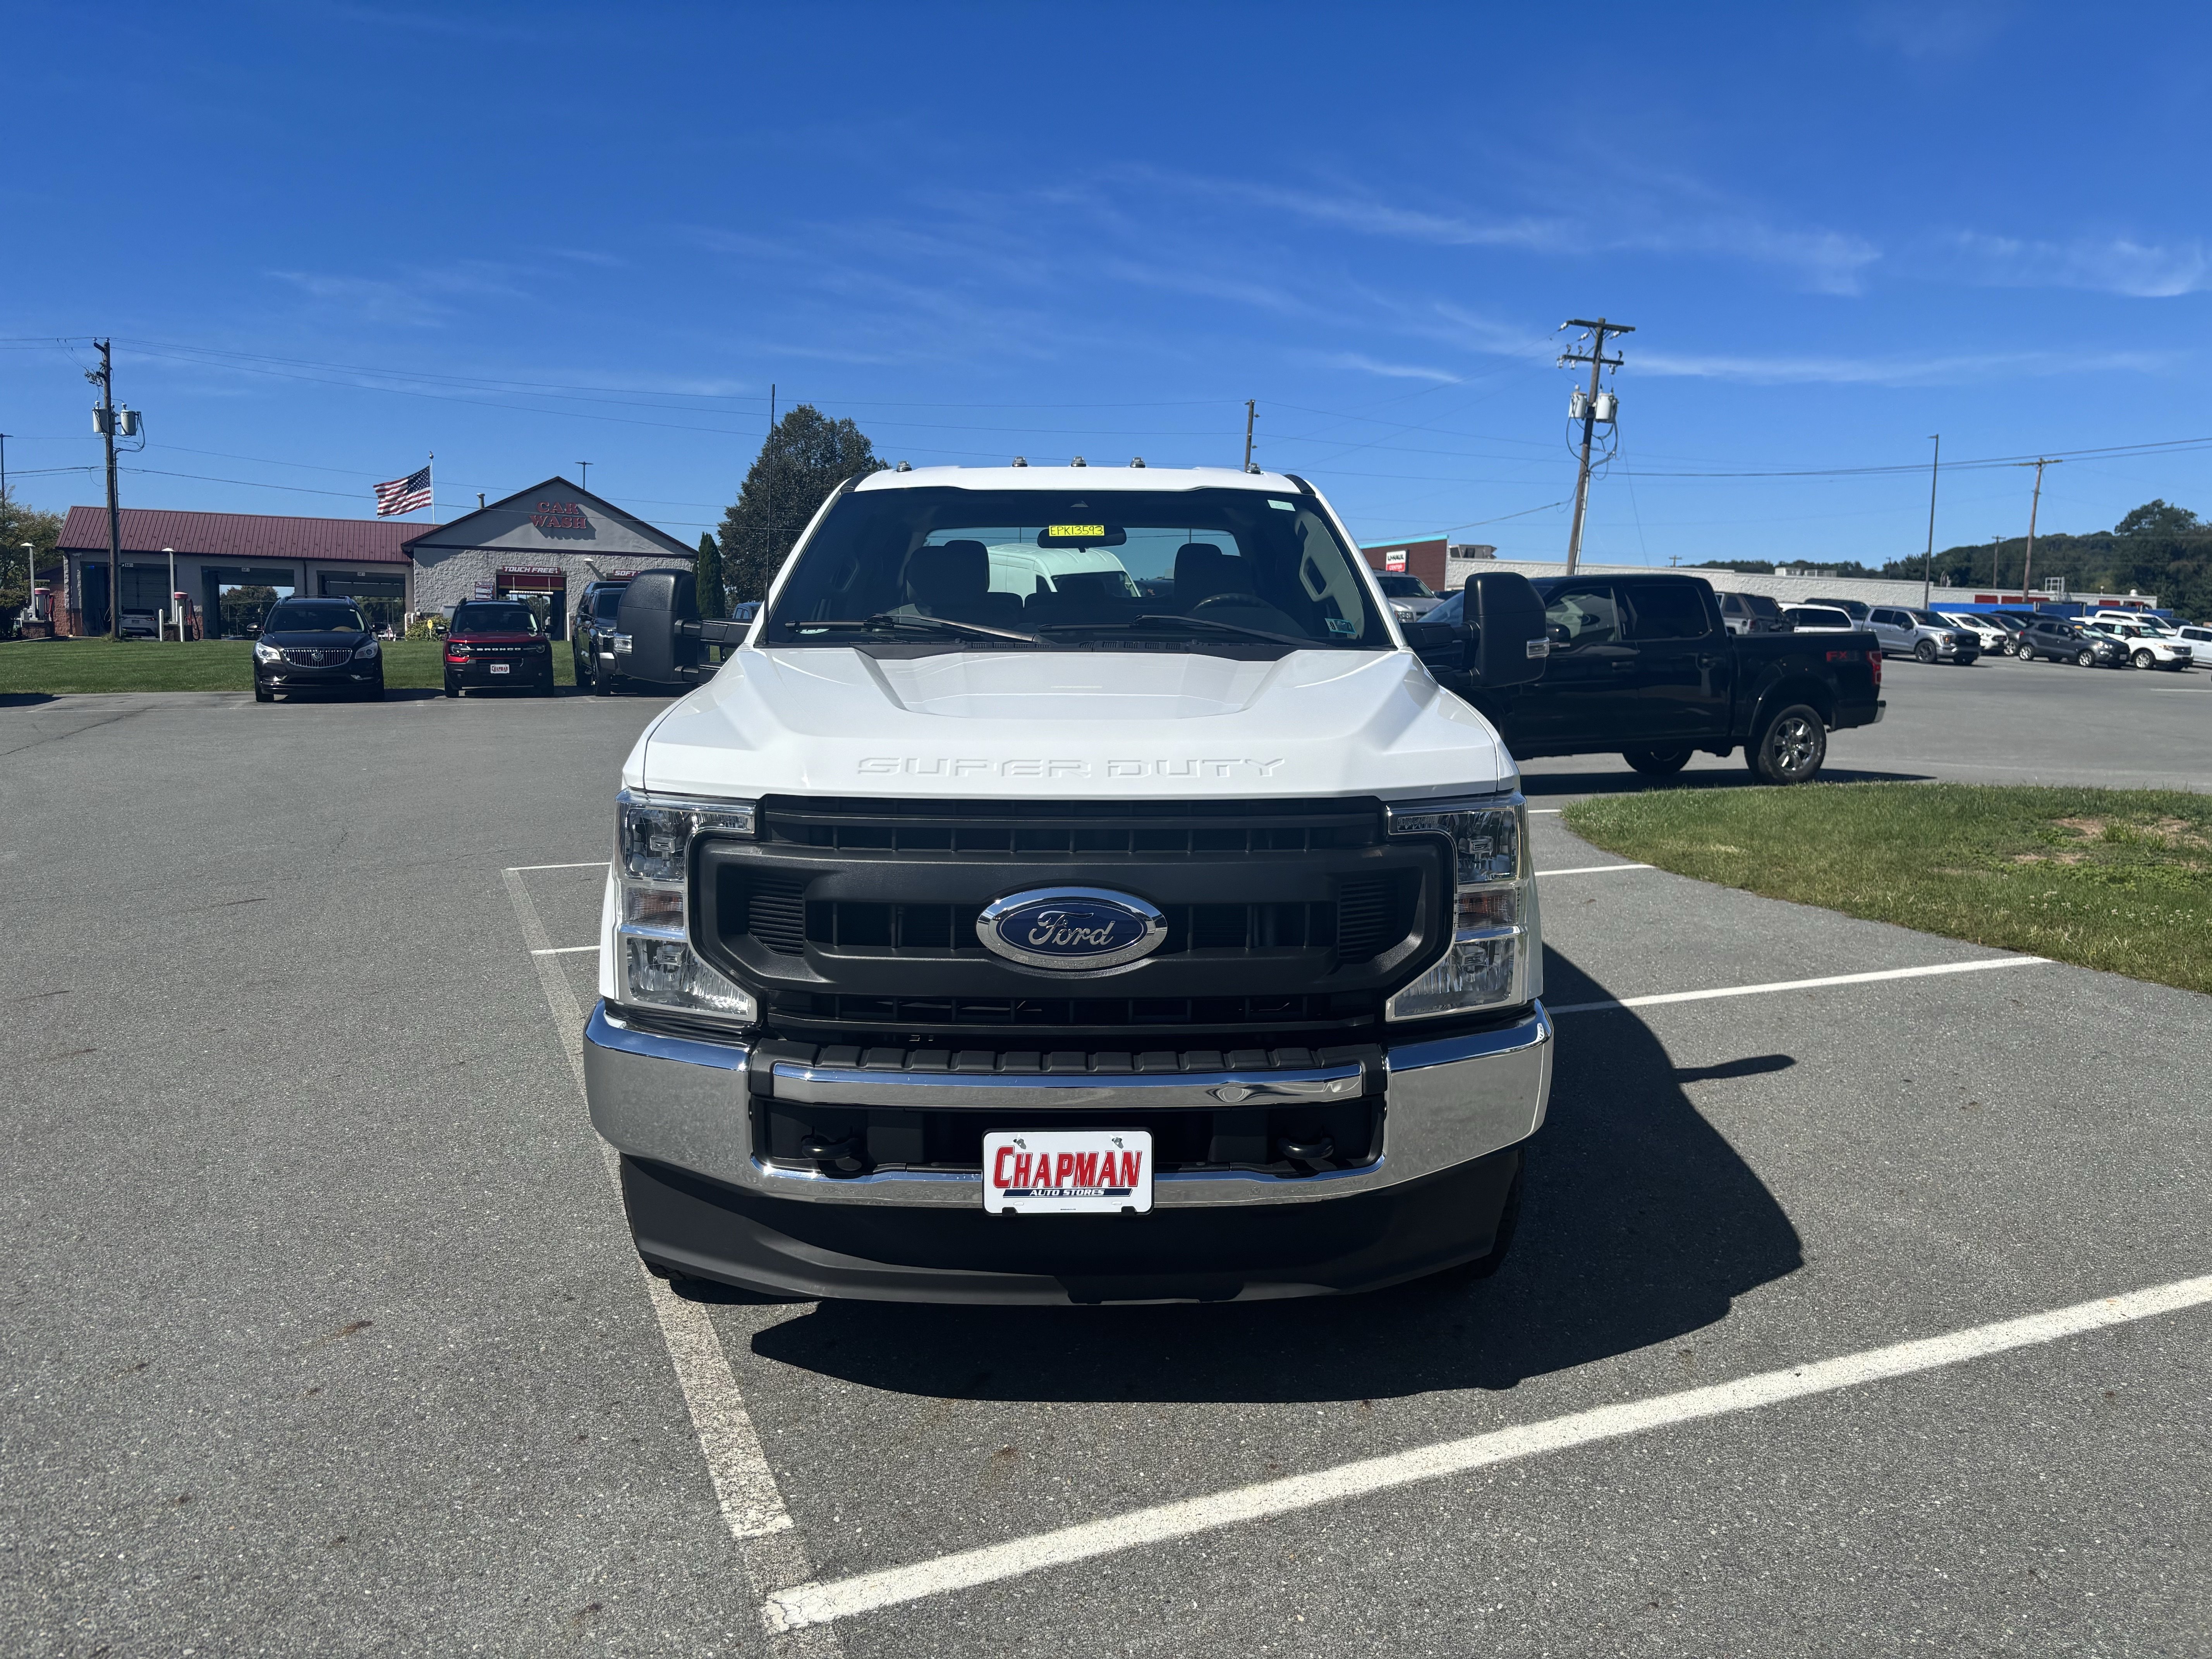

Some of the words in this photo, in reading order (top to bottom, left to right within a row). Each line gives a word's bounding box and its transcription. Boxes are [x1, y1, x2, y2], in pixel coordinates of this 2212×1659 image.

[537, 501, 579, 514] CAR
[529, 515, 586, 529] WASH
[1051, 526, 1103, 535] EPK13593
[857, 757, 1091, 778] SUPER
[1107, 757, 1286, 778] DUTY
[1028, 910, 1116, 945] Ford
[993, 1146, 1142, 1189] CHAPMAN
